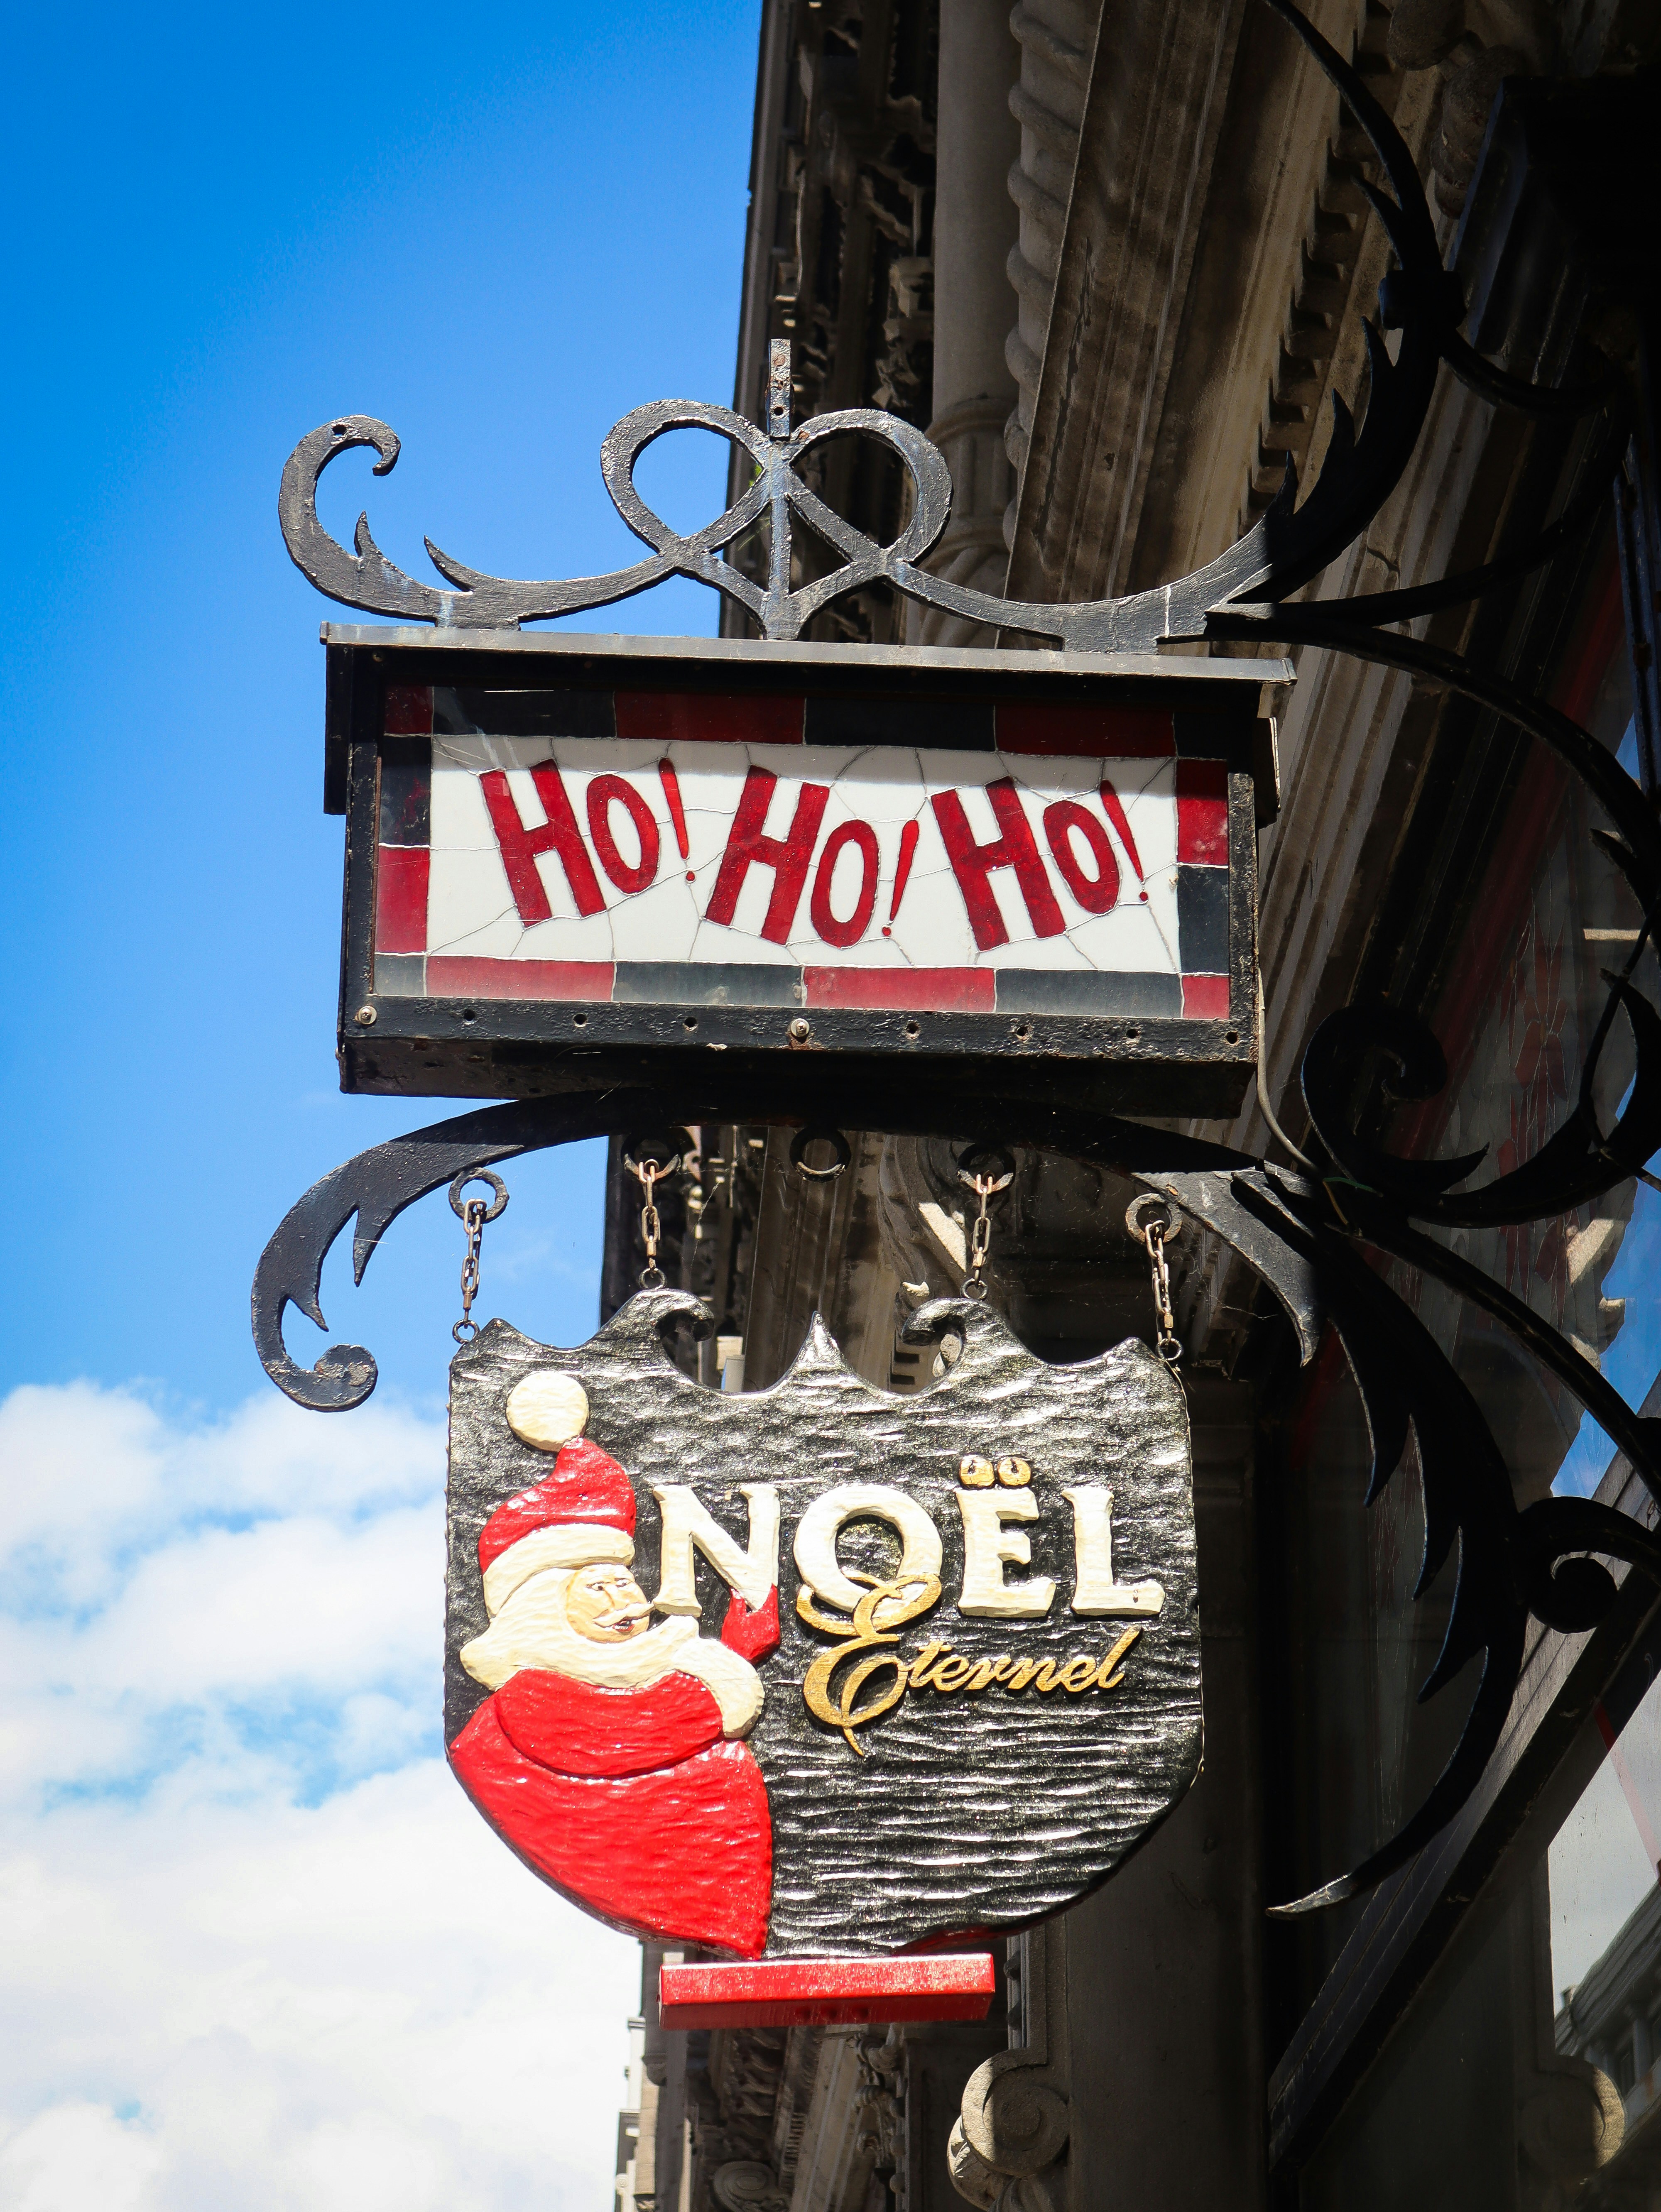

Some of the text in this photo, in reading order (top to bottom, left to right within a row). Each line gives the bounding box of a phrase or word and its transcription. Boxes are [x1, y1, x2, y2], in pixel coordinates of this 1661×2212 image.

[480, 758, 1148, 952] HO! HO! HO!
[653, 1455, 1164, 1617] NOËL
[796, 1574, 1142, 1757] Eternel
